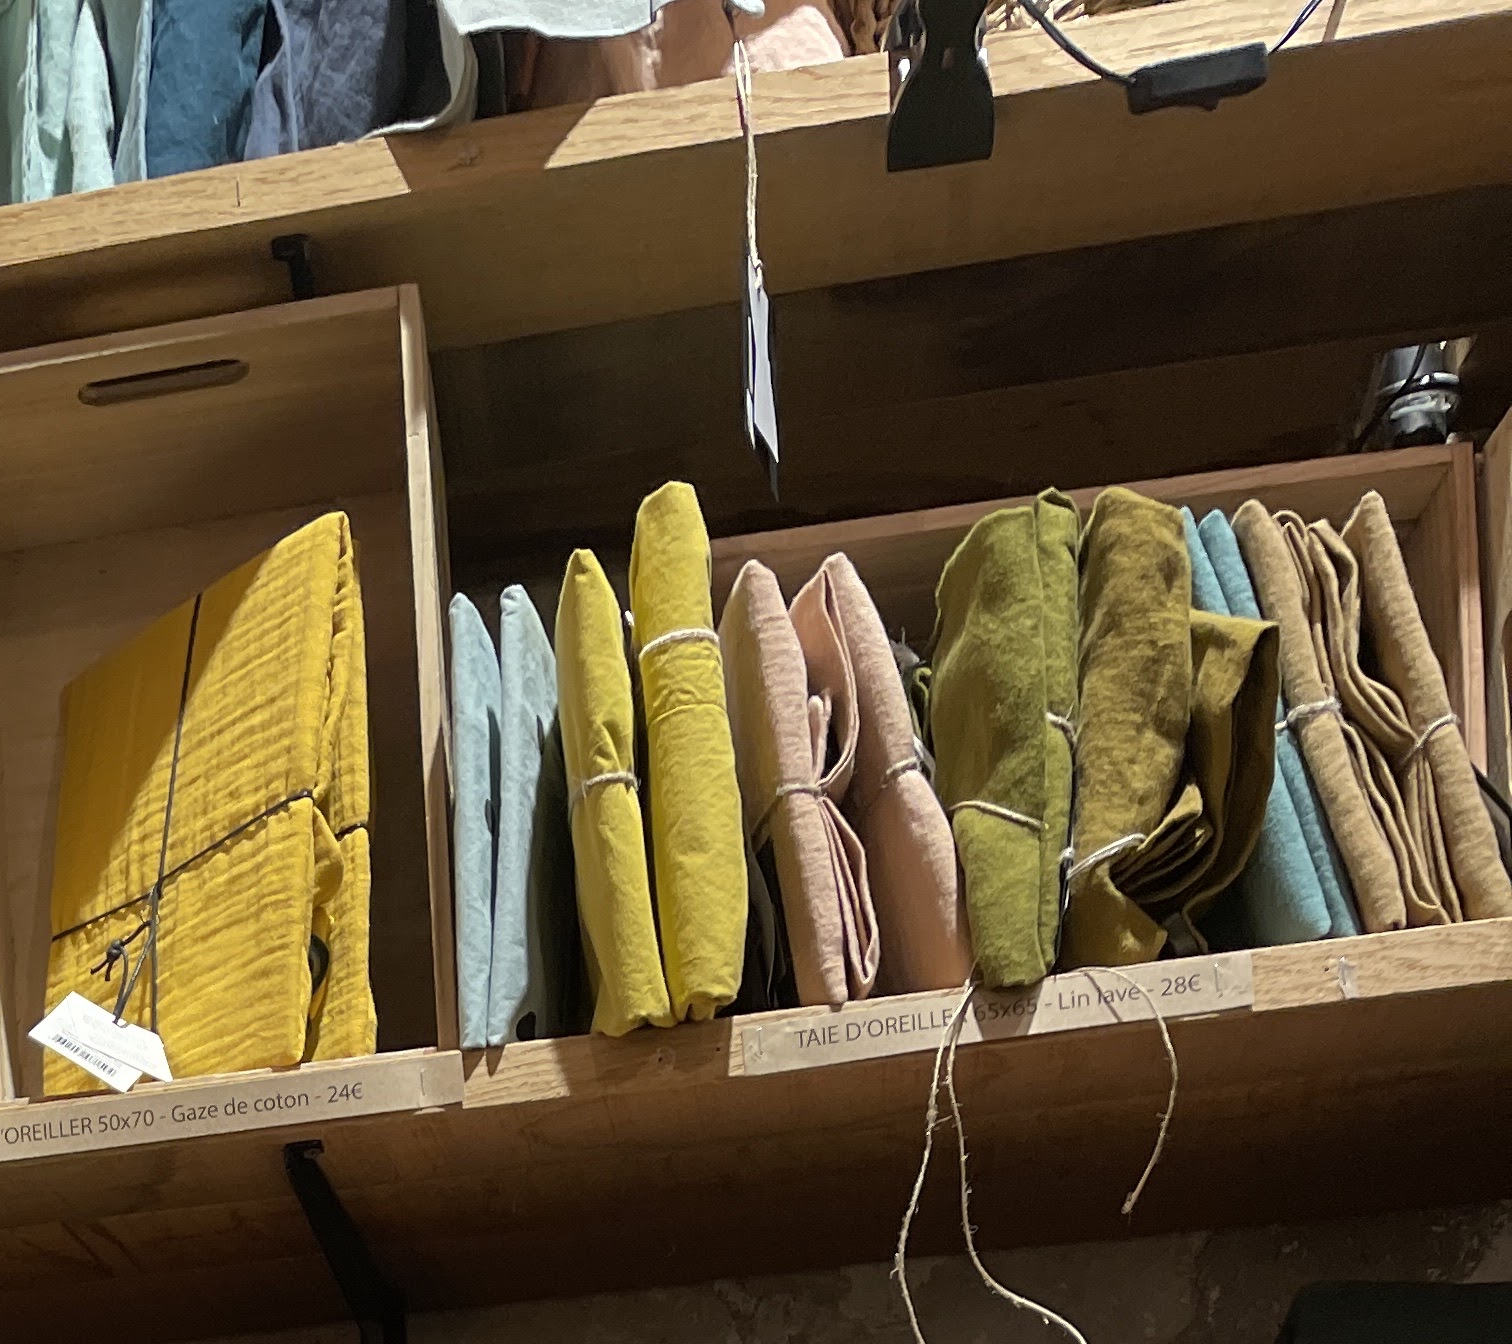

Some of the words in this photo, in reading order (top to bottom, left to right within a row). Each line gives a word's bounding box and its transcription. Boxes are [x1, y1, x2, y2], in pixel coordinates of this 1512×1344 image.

[794, 1024, 839, 1049] TAIE
[974, 999, 1037, 1021] 65x65
[1058, 990, 1090, 1011] Lin
[1097, 979, 1141, 1004] lavé
[1161, 973, 1201, 997] 28€
[98, 1109, 154, 1133] 50x70
[172, 1104, 219, 1123] Gaze
[224, 1096, 248, 1117] de
[254, 1093, 309, 1113] coton
[328, 1081, 363, 1104] 24€
